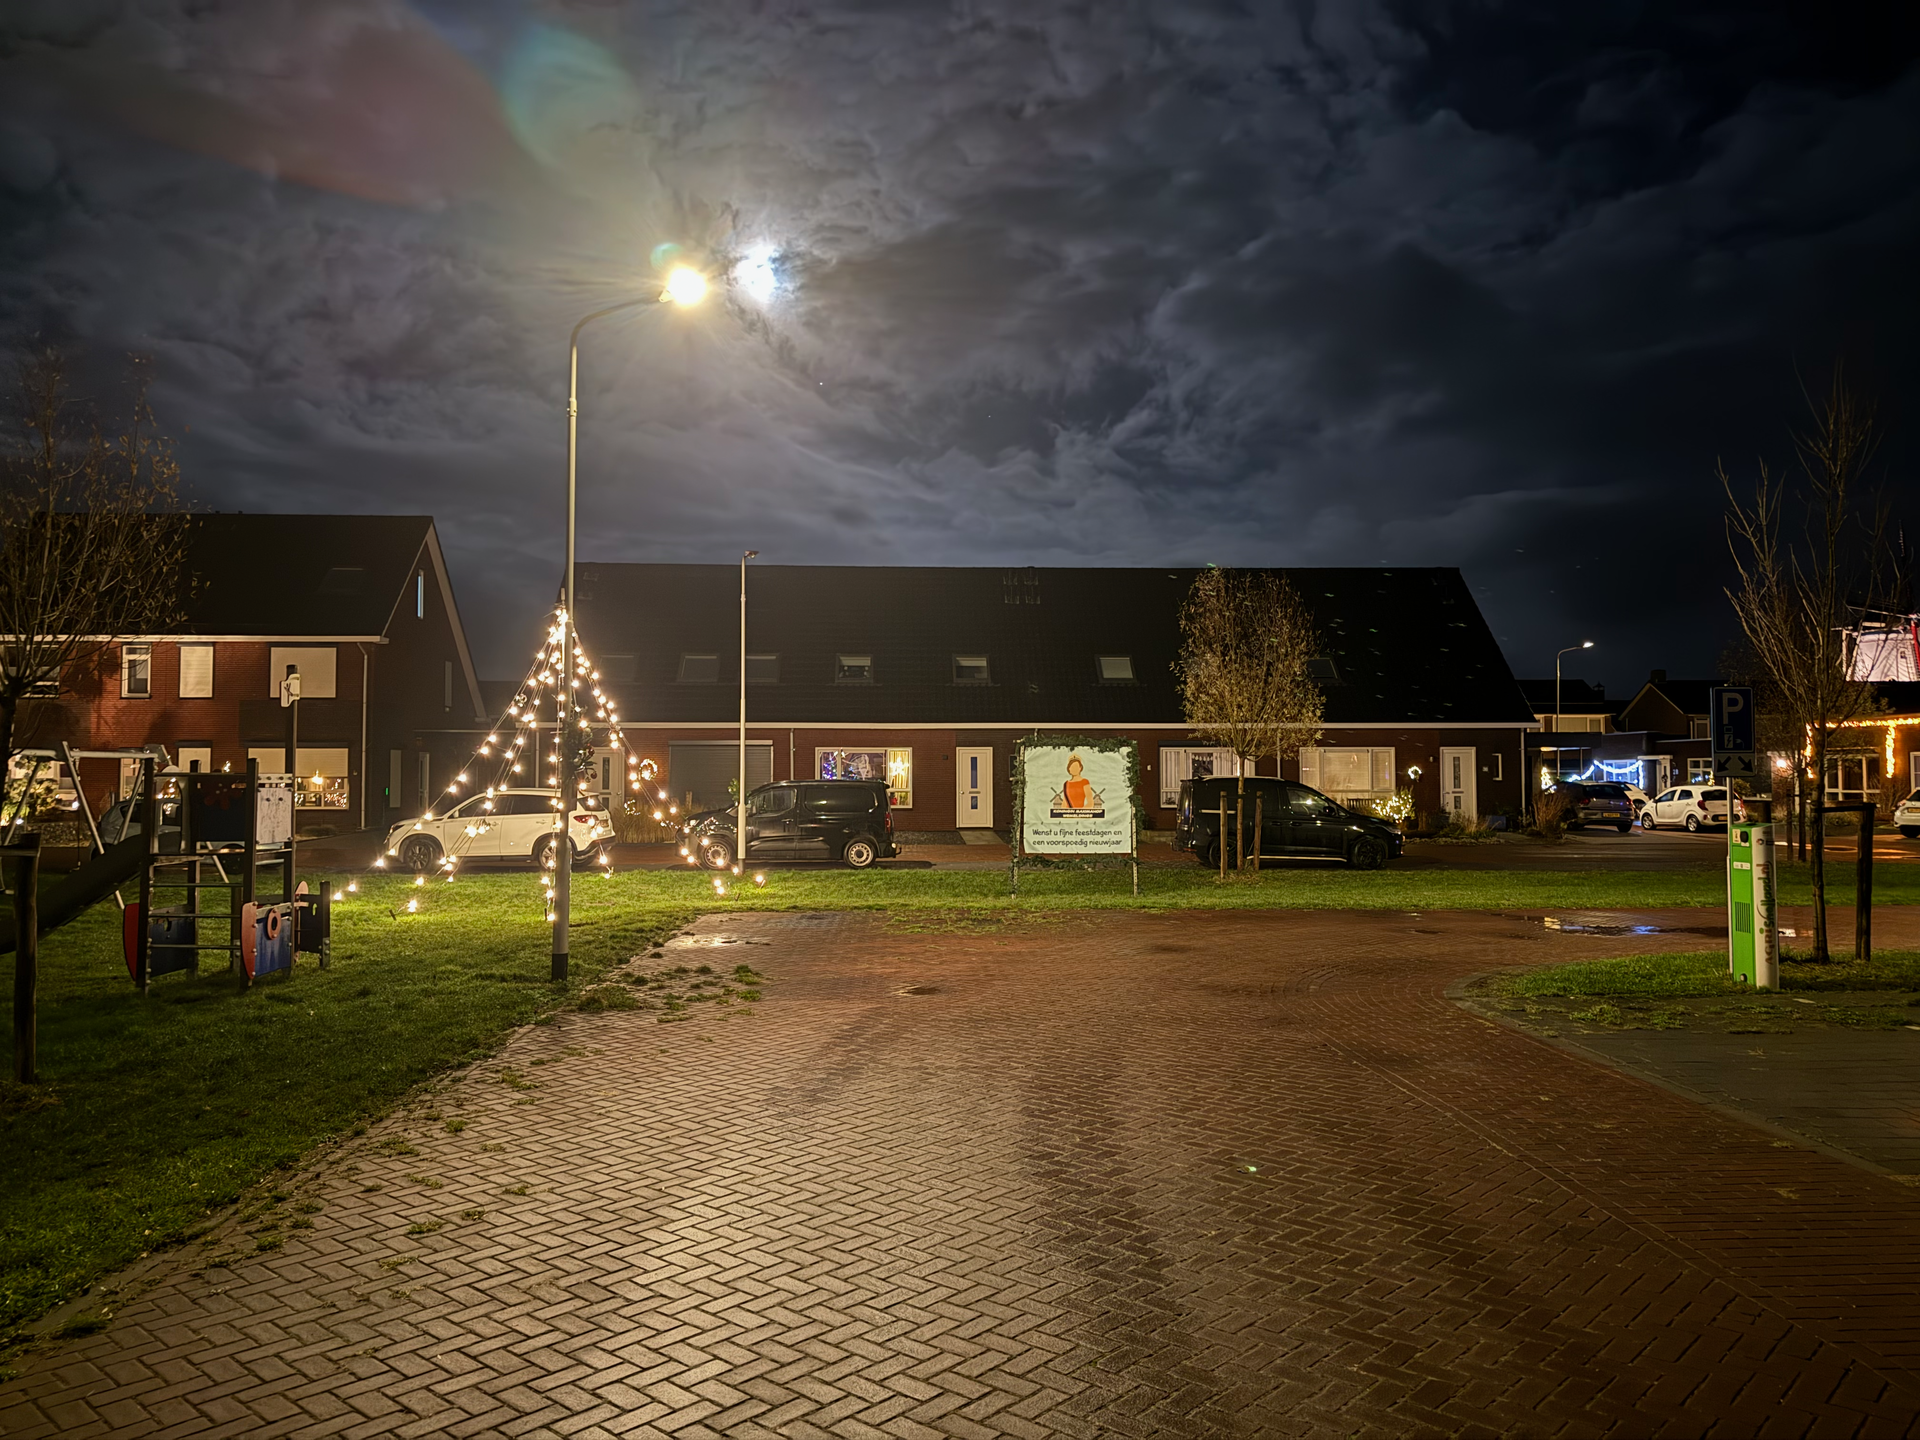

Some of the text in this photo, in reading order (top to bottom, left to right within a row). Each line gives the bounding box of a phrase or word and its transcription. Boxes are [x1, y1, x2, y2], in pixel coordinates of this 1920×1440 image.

[1722, 692, 1744, 725] P
[1032, 828, 1052, 836] Wenst
[1059, 828, 1073, 838] fijne
[1075, 828, 1112, 838] feestdagen
[1046, 839, 1088, 847] voorspoedig
[1089, 839, 1122, 847] nieuwjaar
